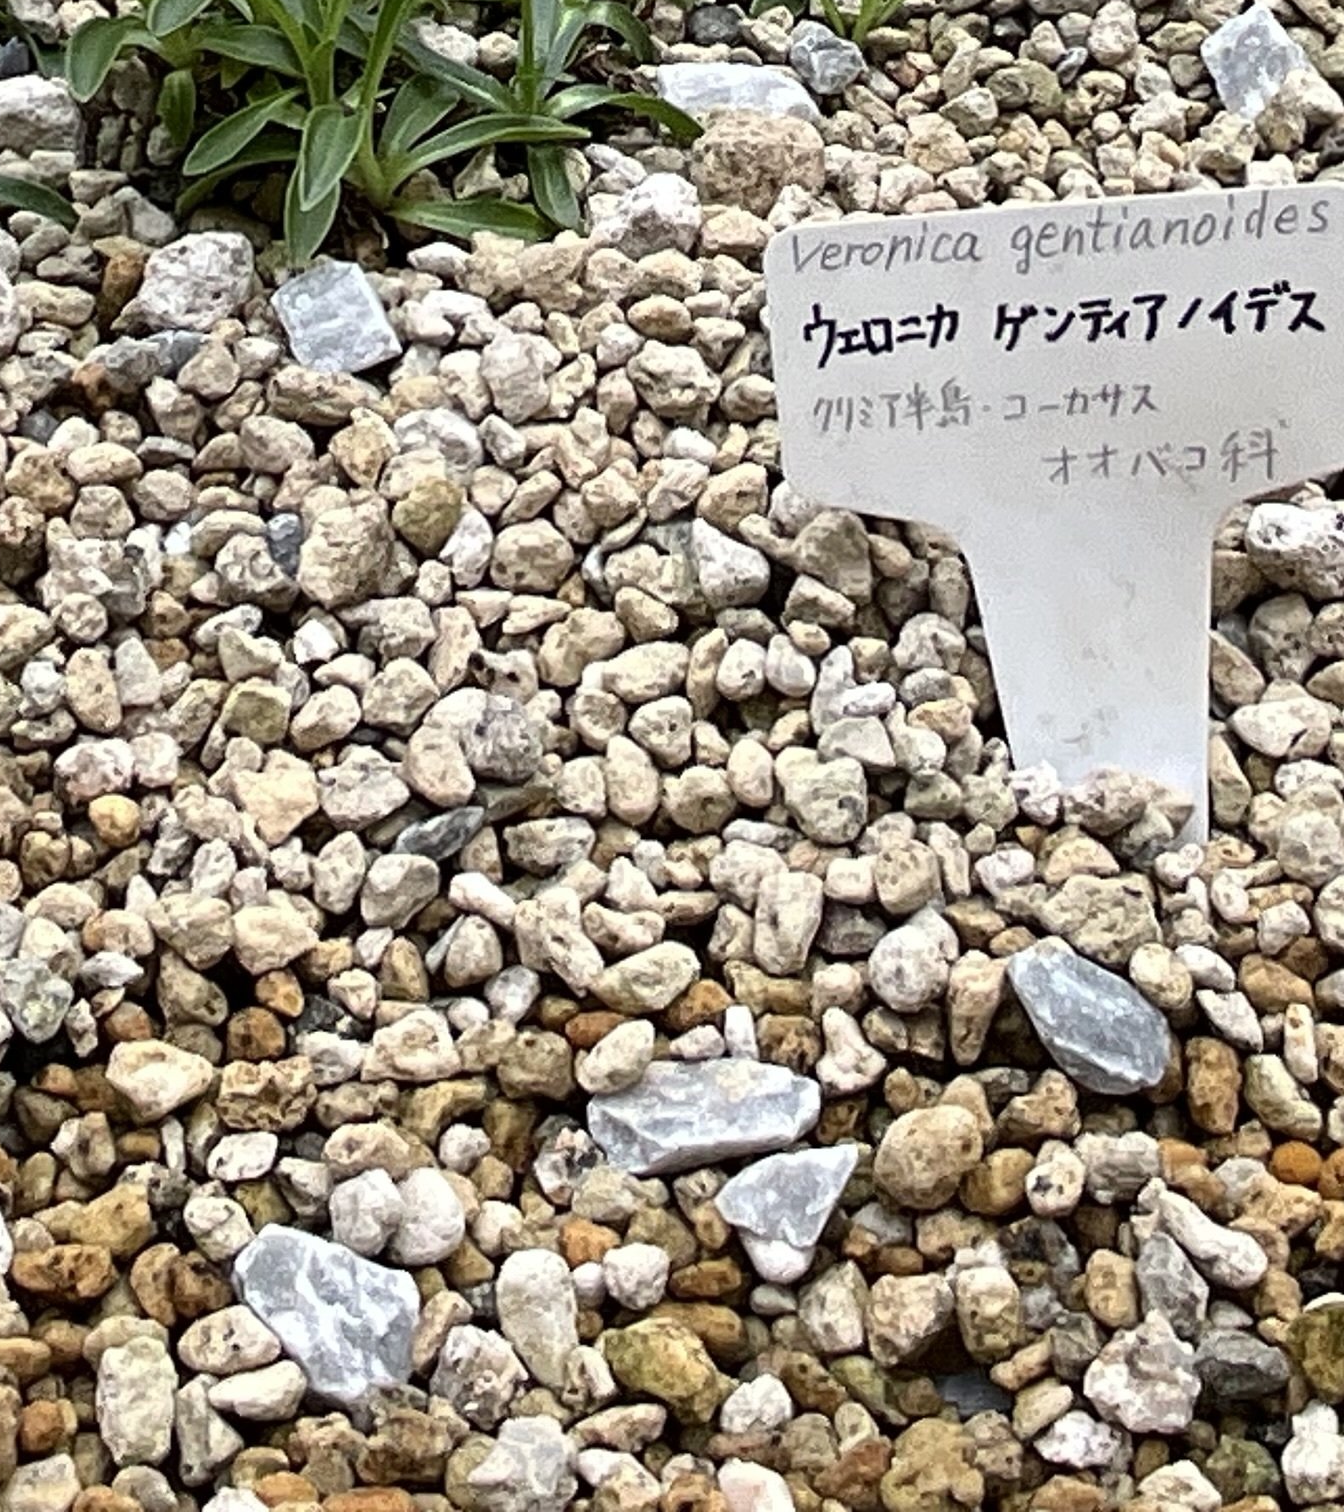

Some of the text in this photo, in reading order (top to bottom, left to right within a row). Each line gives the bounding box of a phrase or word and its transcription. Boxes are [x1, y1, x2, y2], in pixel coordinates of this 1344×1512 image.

[1010, 190, 1330, 275] gentianoides
[803, 280, 1325, 369] ウェロニカ ゲンティアノイデス
[1041, 427, 1279, 485] オオバコ科
